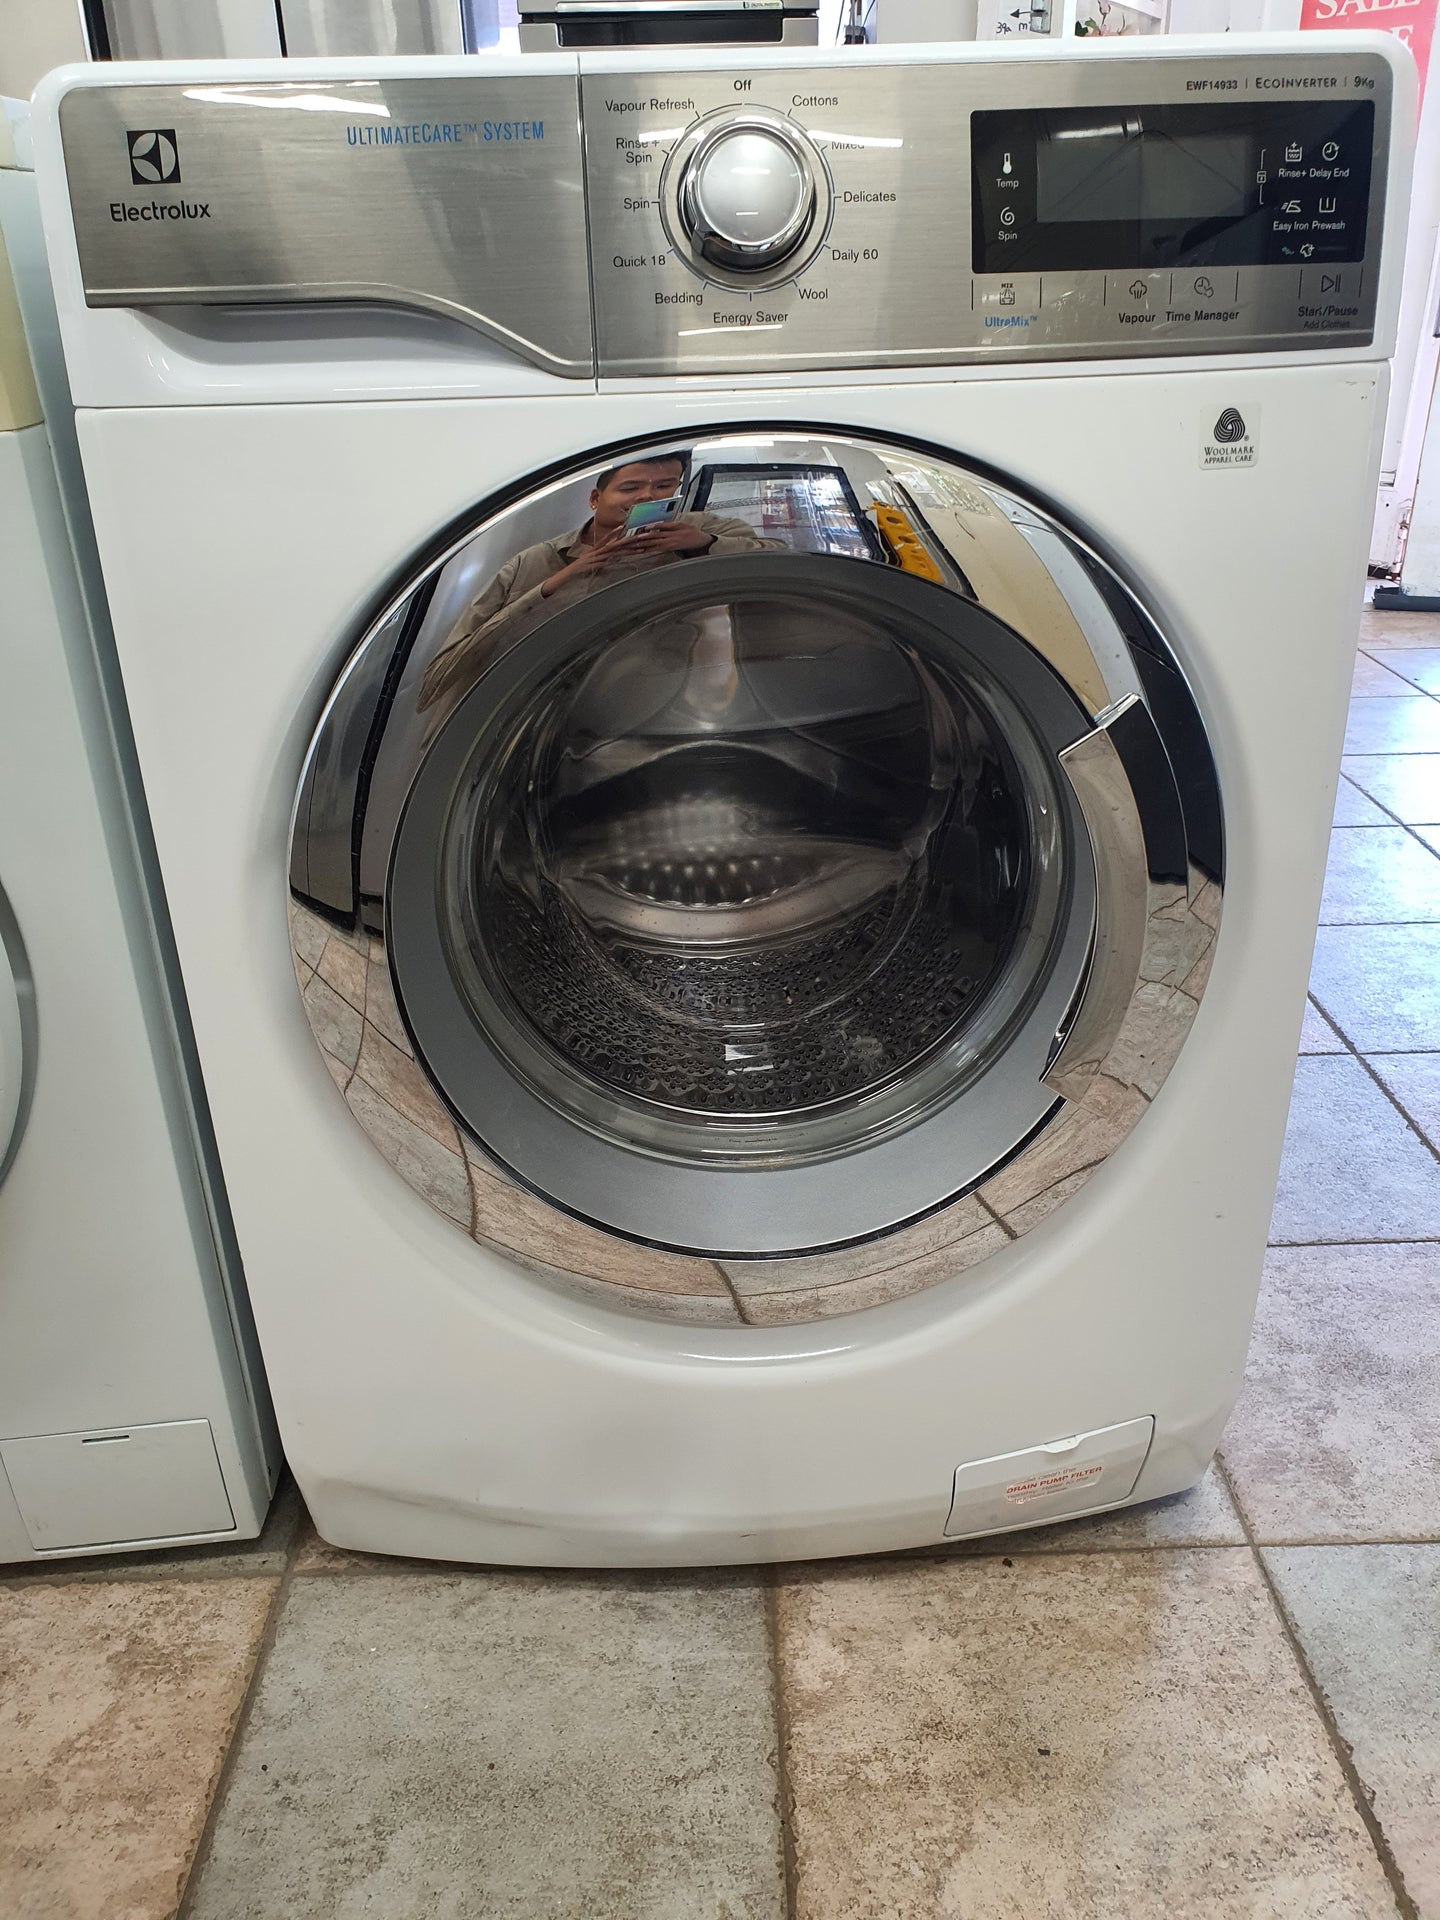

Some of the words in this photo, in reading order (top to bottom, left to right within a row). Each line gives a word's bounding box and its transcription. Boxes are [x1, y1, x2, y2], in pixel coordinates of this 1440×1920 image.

[1315, 0, 1421, 19] SA
[733, 79, 752, 91] Off
[1186, 80, 1238, 91] EWF14933
[605, 100, 647, 115] Vapour
[650, 98, 695, 112] Refresh
[791, 94, 839, 107] Cottons
[483, 121, 545, 141] SYSTEM
[616, 137, 648, 149] Rinse
[625, 151, 652, 166] Spin
[1309, 168, 1332, 180] Delay
[1333, 168, 1350, 177] End
[996, 178, 1019, 189] Temp
[843, 190, 897, 203] Delicates
[623, 197, 650, 212] Spin
[109, 200, 211, 222] Electrolux
[1273, 221, 1292, 232] Easy
[1294, 221, 1309, 230] Iron
[1312, 220, 1346, 230] Prewash
[998, 230, 1018, 242] Spin
[613, 256, 647, 268] Quick
[651, 255, 666, 266] 18
[832, 250, 860, 263] Daily
[863, 249, 879, 260] 60
[655, 293, 703, 305] Bedding
[799, 288, 828, 300] Wool
[713, 312, 752, 326] Energy
[755, 310, 789, 323] Saver
[1118, 313, 1156, 325] Vapour
[1166, 311, 1191, 322] Time
[1194, 310, 1240, 322] Manager
[1204, 446, 1254, 456] WOOLMARK
[1234, 455, 1252, 463] CARE
[1006, 1483, 1037, 1494] DRAIN
[1040, 1475, 1069, 1487] PUMP
[1071, 1466, 1102, 1478] FILTER
